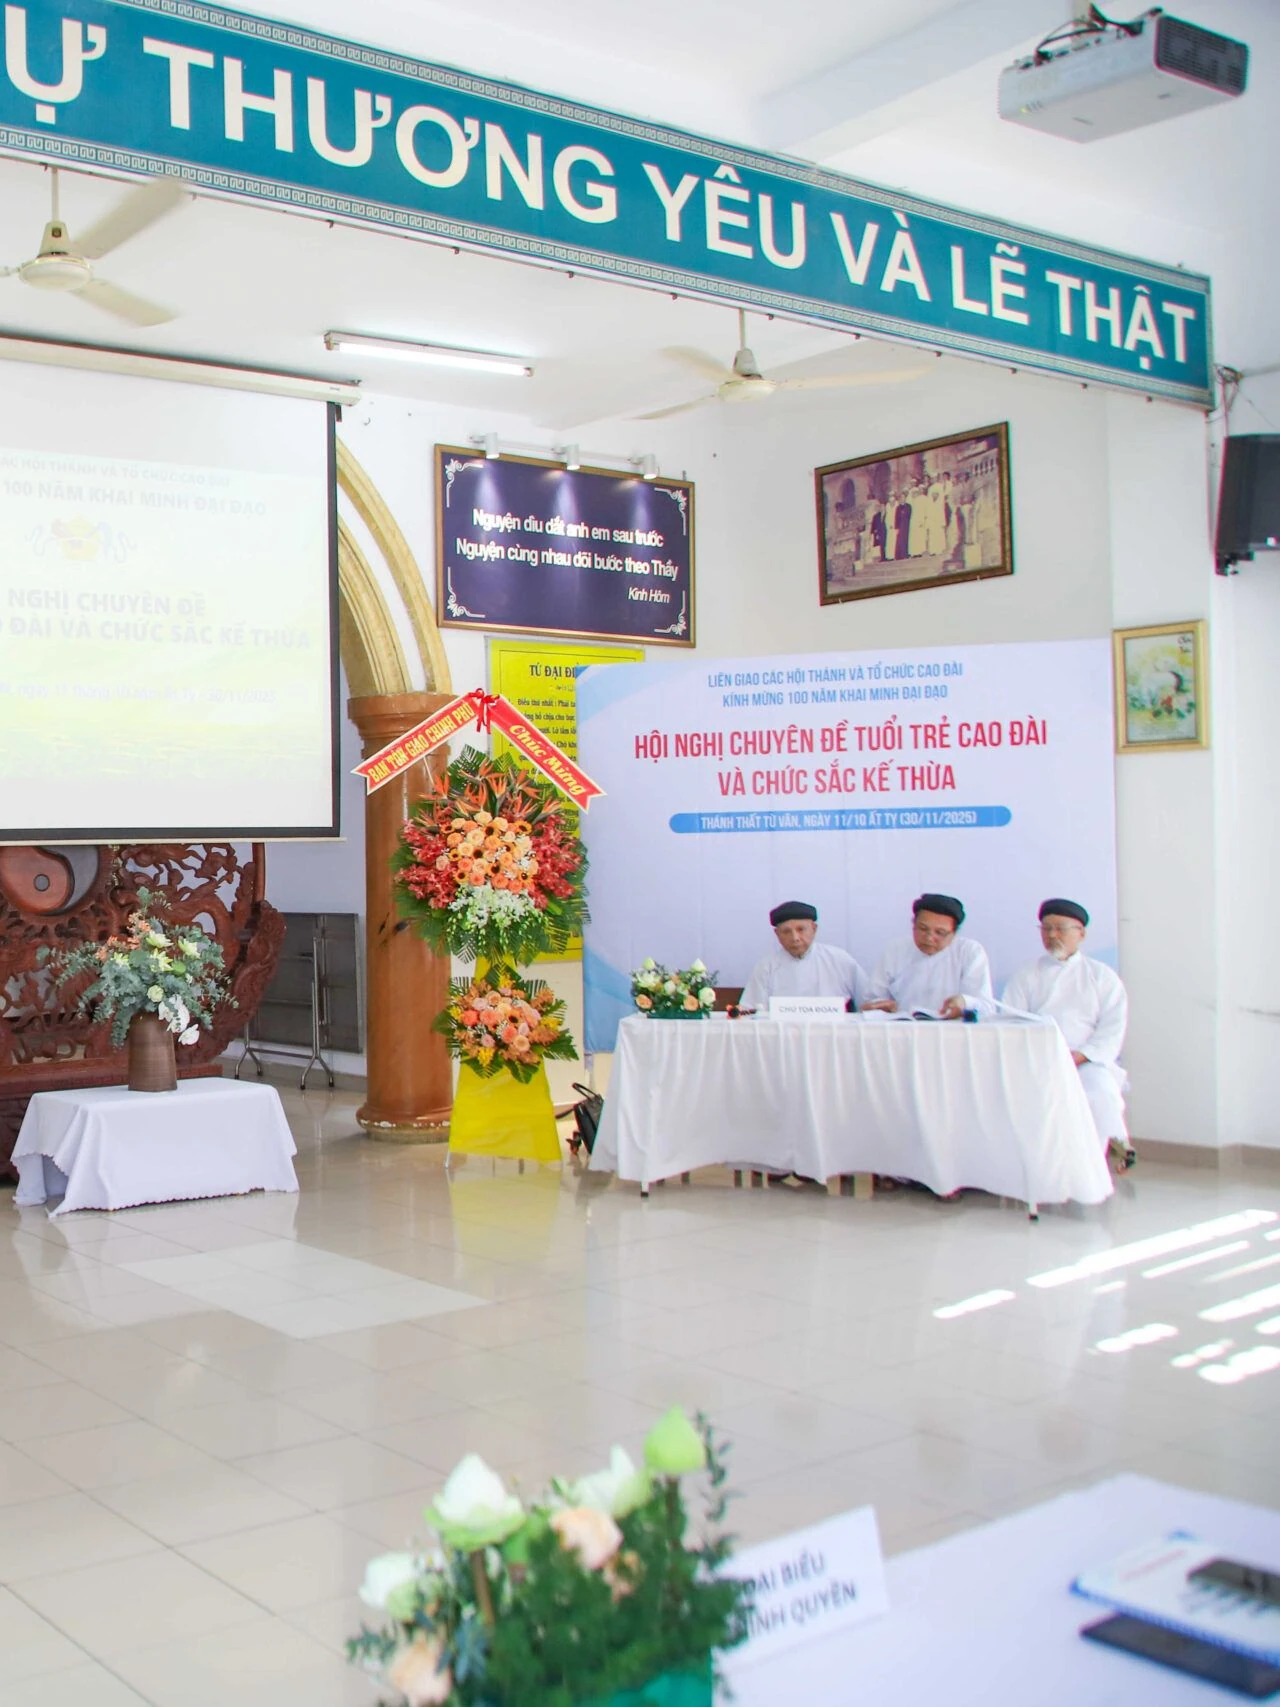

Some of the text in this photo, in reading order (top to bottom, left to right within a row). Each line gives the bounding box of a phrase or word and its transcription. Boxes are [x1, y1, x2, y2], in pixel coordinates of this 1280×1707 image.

[143, 38, 617, 223] THƯƠNG
[643, 163, 806, 269] YÊU
[830, 210, 931, 302] VÀ
[951, 243, 1030, 326] LẼ
[1045, 270, 1196, 370] THẬT
[472, 508, 664, 547] Nguyện dìu dắt anh em sau trước
[456, 538, 678, 581] Nguyện cùng nhau dõi bước theo Thầy
[7, 588, 69, 616] NGHỊ
[76, 590, 170, 617] CHUYÊN
[176, 591, 206, 617] ĐỀ
[10, 613, 51, 638] ĐÀI
[59, 615, 92, 639] VÀ
[99, 618, 163, 643] CHỨC
[169, 618, 212, 645] SẮC
[219, 621, 246, 647] KẾ
[250, 624, 311, 649] THỪA
[708, 661, 963, 688] LIÊN GIAO CÁC HỘI THÁNH VÀ TỔ CHỨC CAO ĐÀI
[722, 685, 947, 708] KÍNH MỪNG 100 NĂM KHAI MINH ĐẠI ĐẠO
[635, 714, 1047, 763] HỘI NGHỊ CHUYÊN ĐỀ TUỔI TRẺ CAO ĐÀI
[717, 759, 956, 796] VÀ CHỨC SẮC KẾ THỪA
